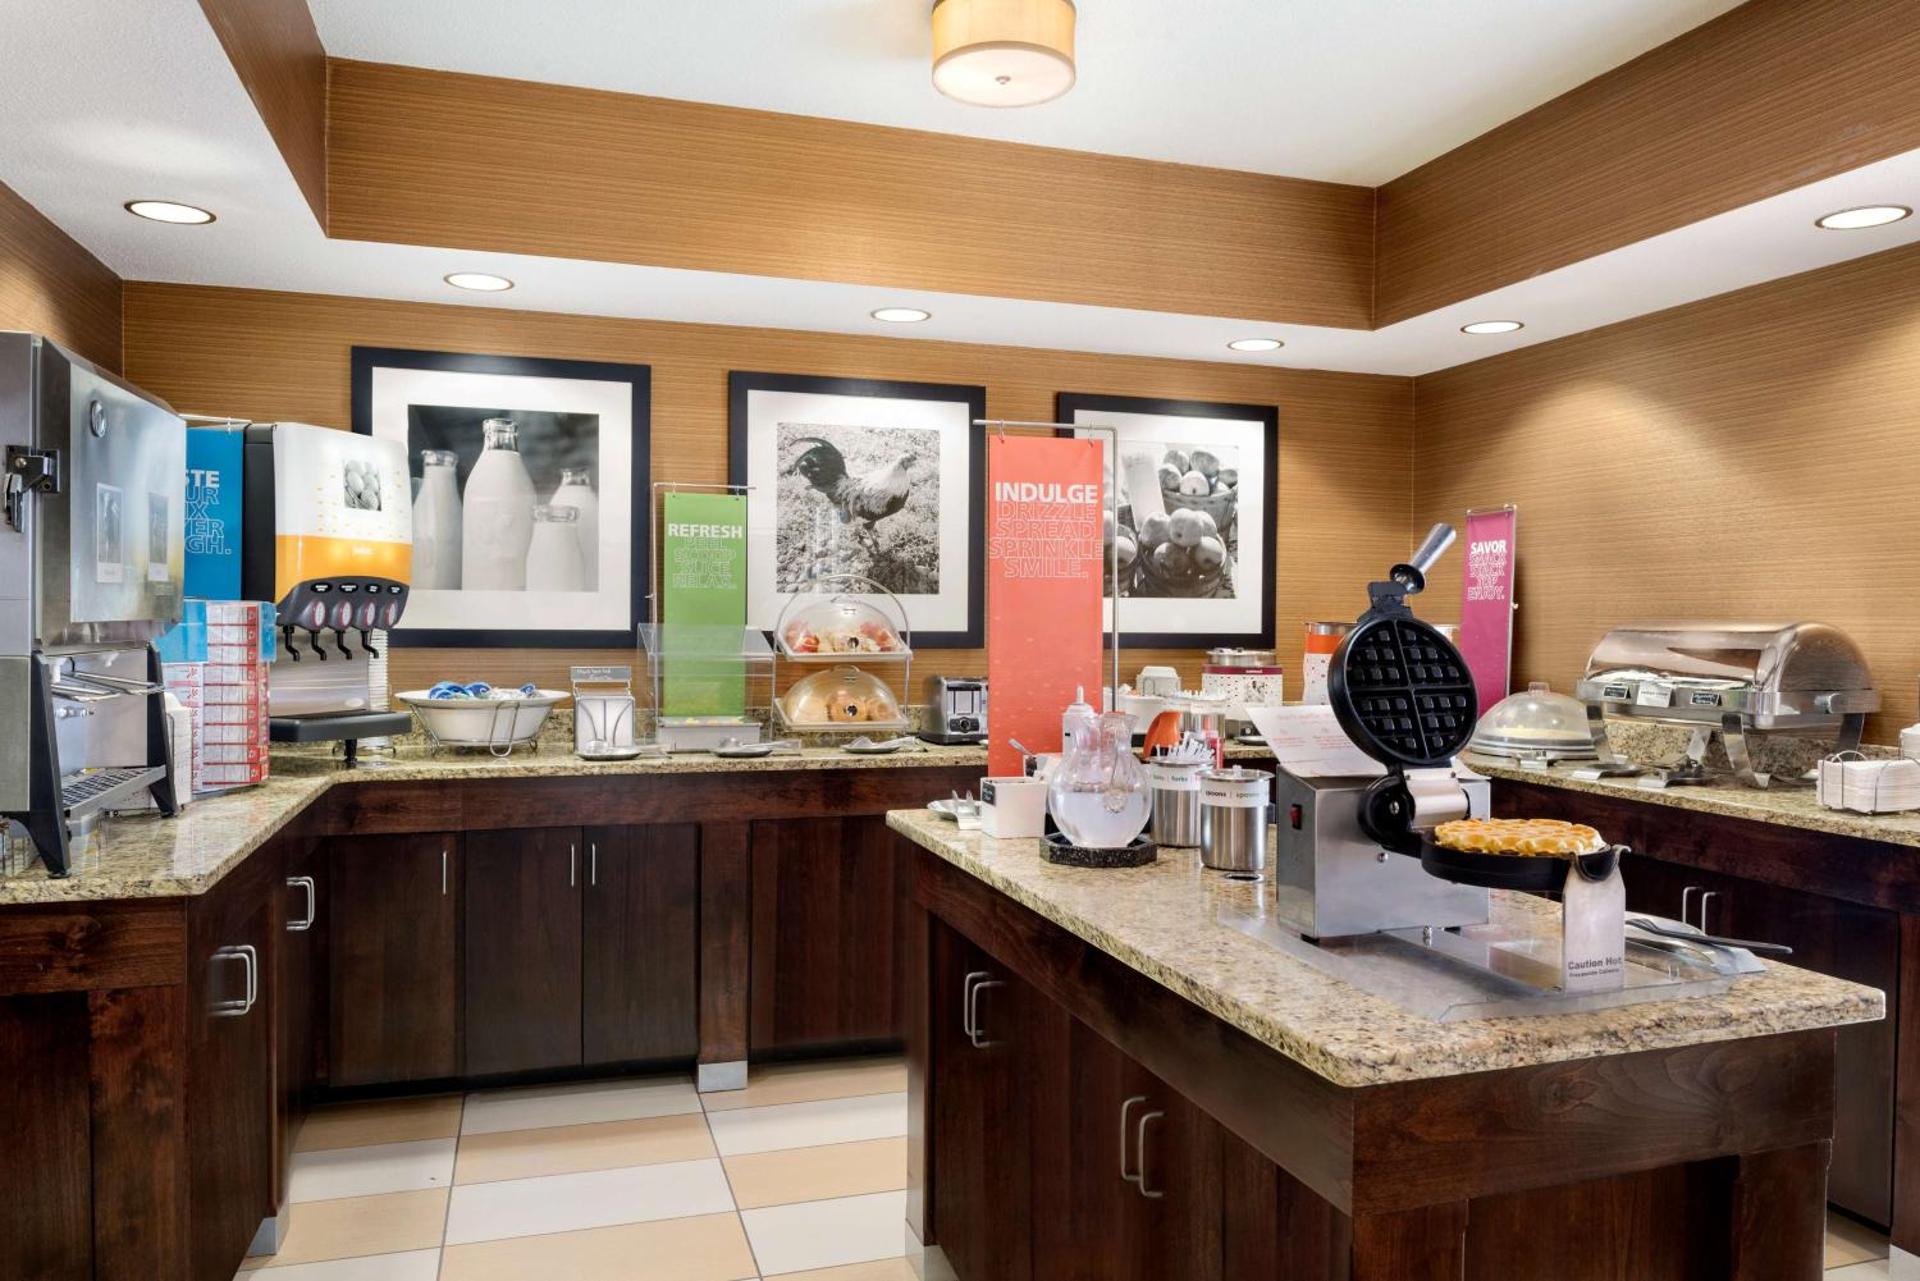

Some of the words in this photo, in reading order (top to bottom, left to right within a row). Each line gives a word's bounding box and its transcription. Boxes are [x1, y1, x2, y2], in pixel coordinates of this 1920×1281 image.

[995, 481, 1098, 504] INDULGE
[997, 501, 1096, 521] DRIZZLE
[668, 523, 743, 538] REFRESH
[997, 519, 1096, 540] SPREAD
[989, 537, 1104, 560] SPRINKLE
[1470, 540, 1507, 554] SAVOR
[1004, 557, 1089, 578] SMILE.
[1568, 960, 1603, 970] Caution
